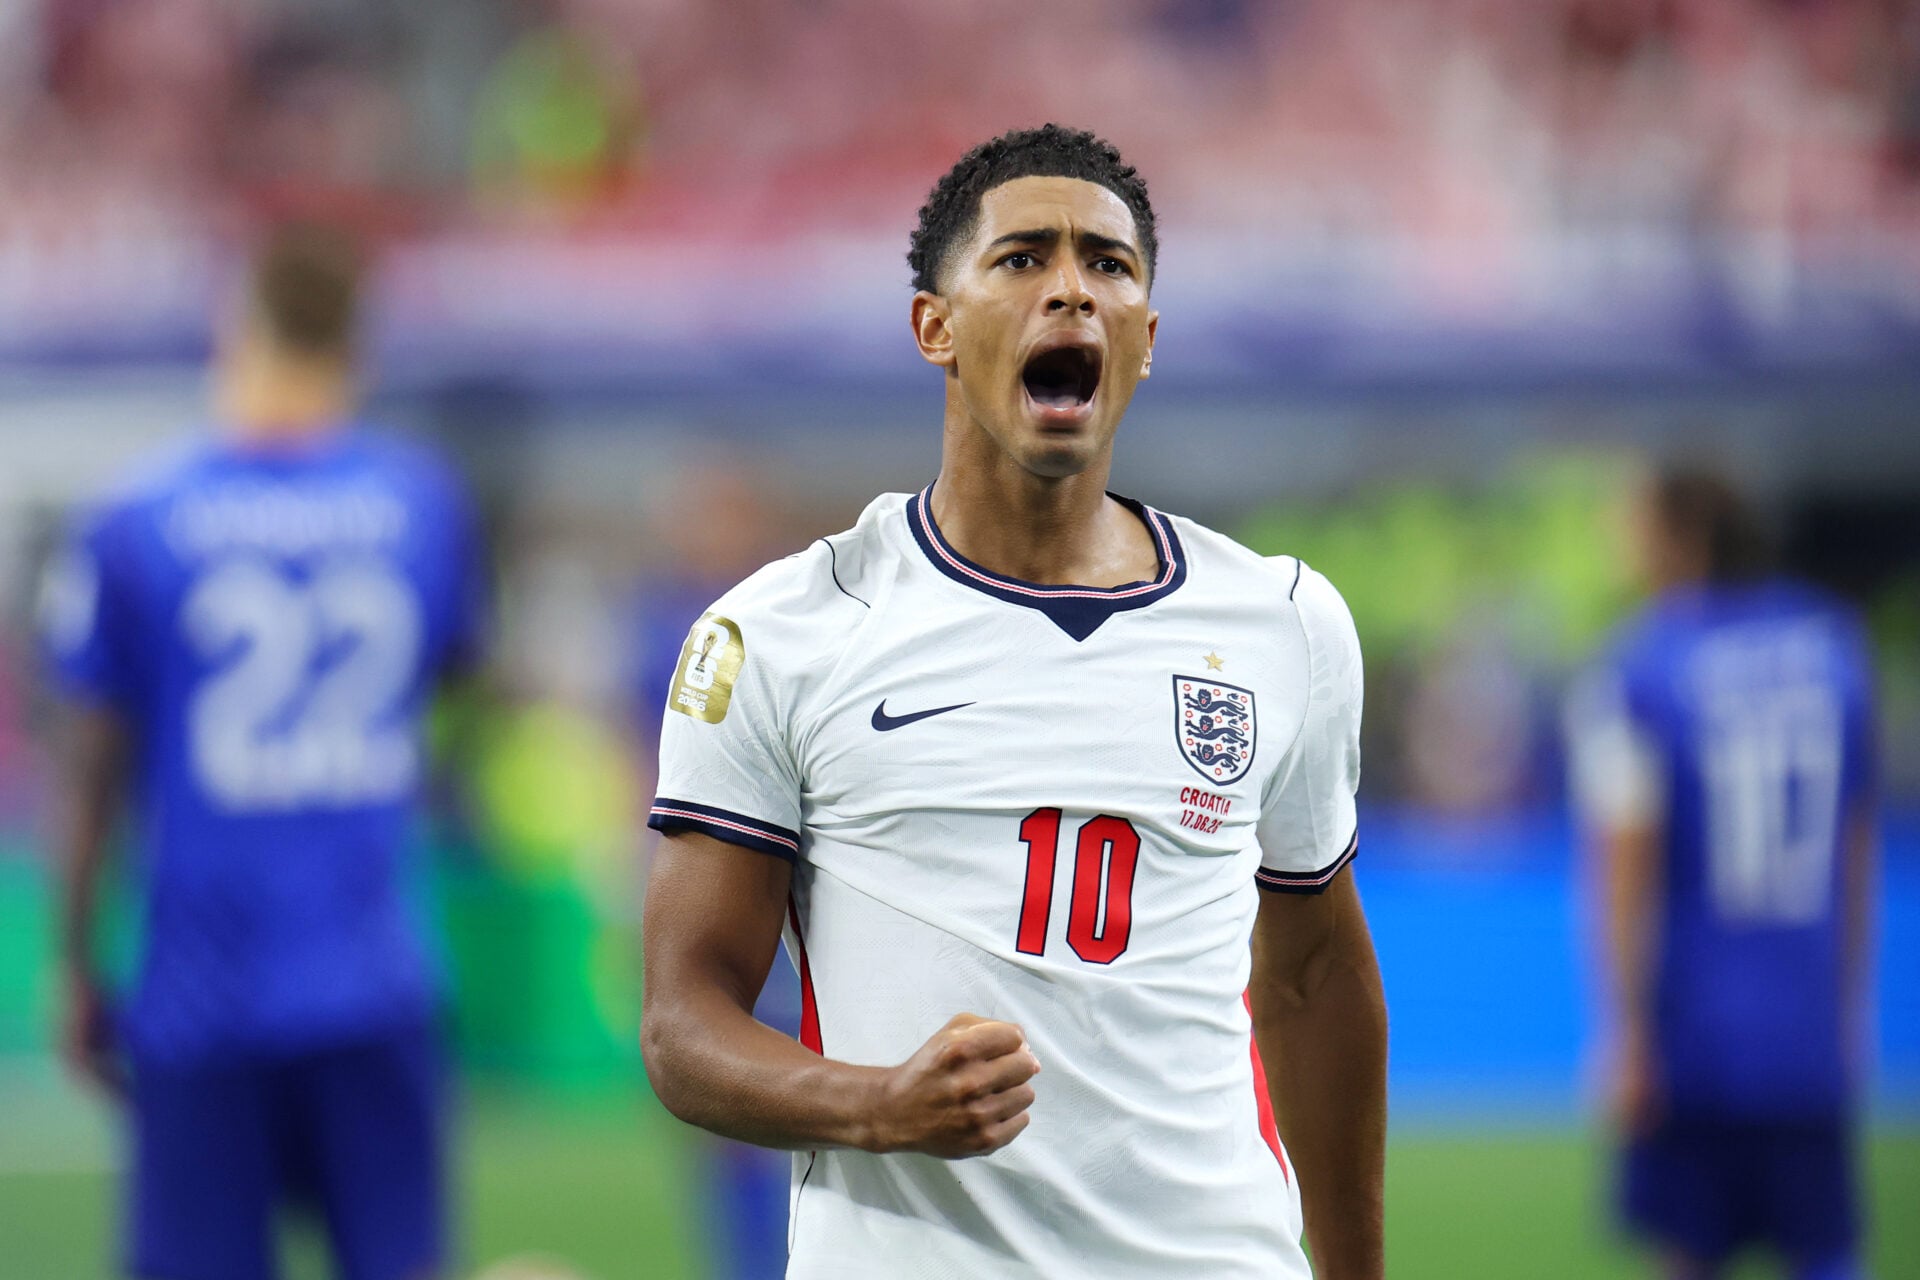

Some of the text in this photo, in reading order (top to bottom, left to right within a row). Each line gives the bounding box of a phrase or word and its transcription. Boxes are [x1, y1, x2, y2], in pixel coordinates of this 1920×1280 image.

[185, 556, 420, 808] 22
[677, 693, 707, 711] 2026
[1180, 787, 1231, 816] CROATIA
[1016, 806, 1141, 965] 10
